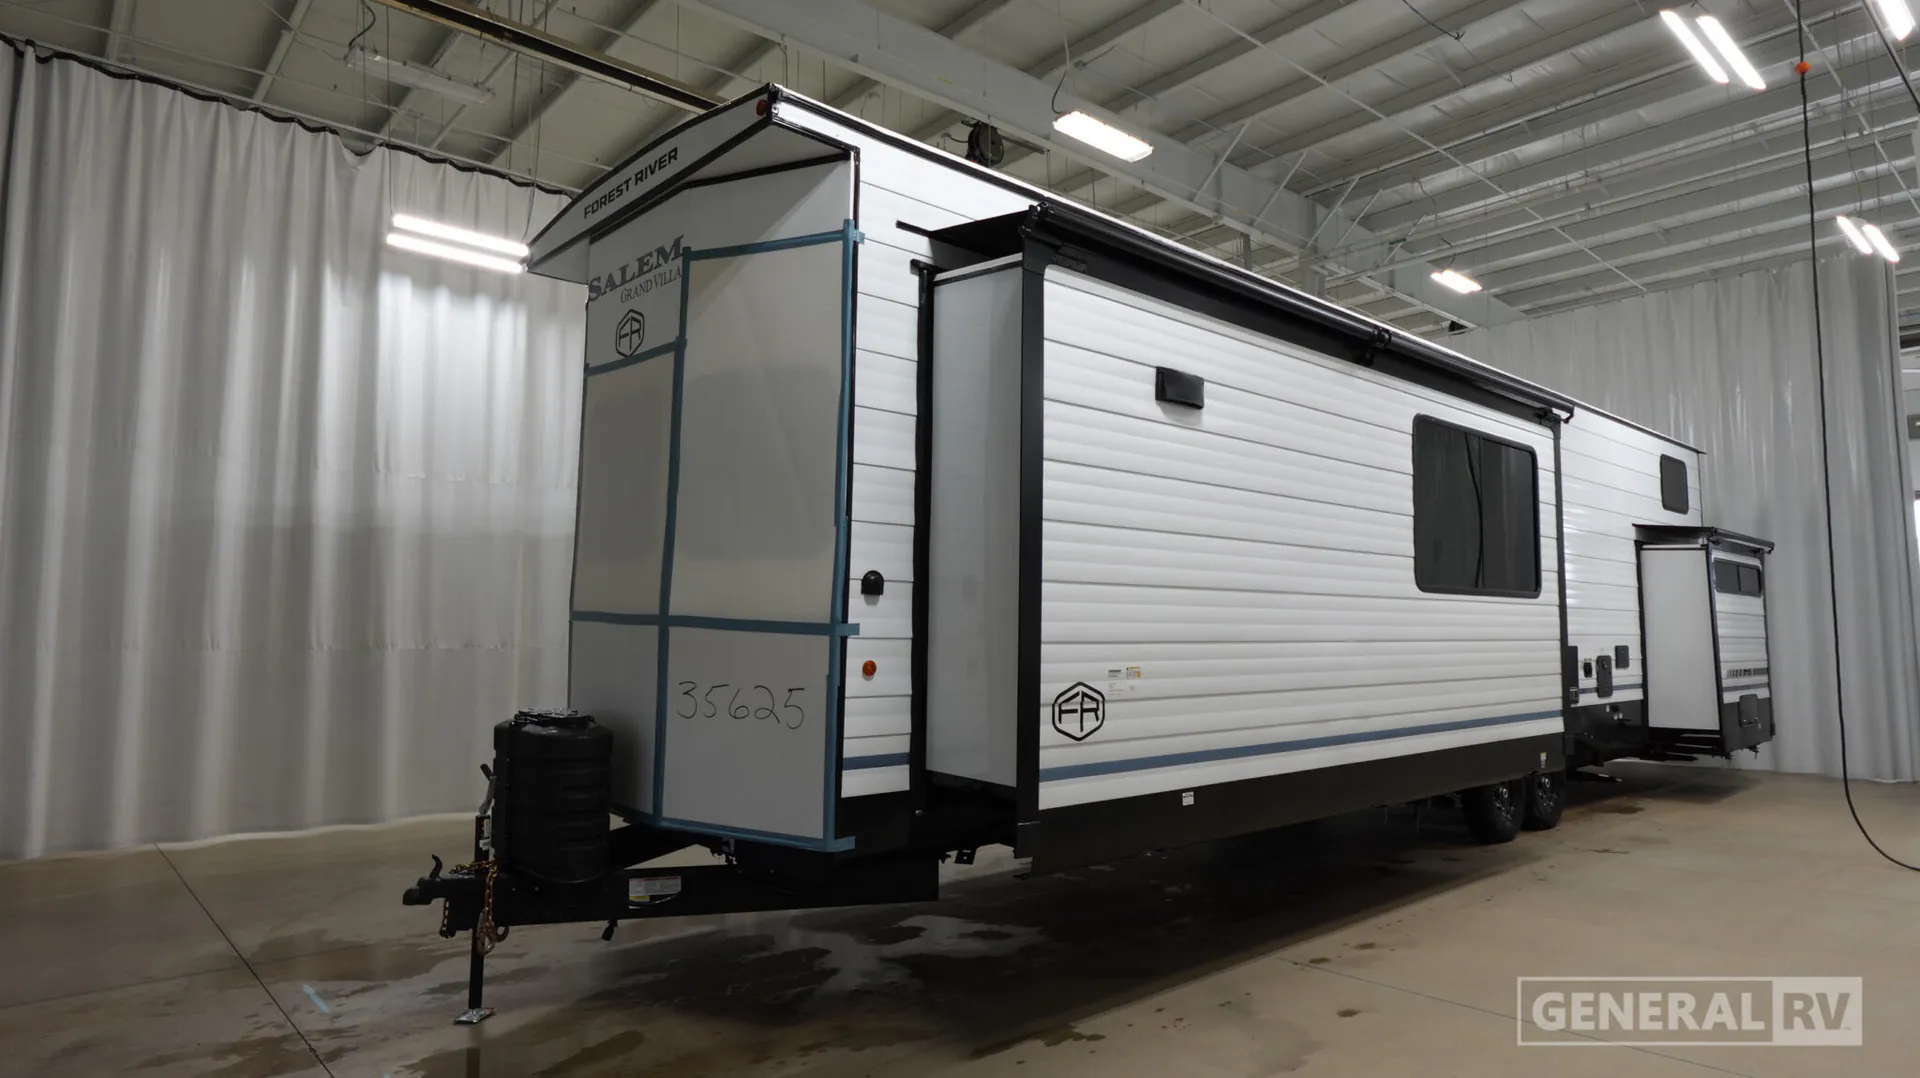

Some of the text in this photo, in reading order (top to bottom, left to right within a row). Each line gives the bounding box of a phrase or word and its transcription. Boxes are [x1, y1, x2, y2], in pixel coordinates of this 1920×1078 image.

[584, 146, 678, 219] FOREST RIVER
[588, 234, 684, 302] SALEM
[620, 265, 682, 303] GRAND VILLA
[677, 681, 806, 730] 35625
